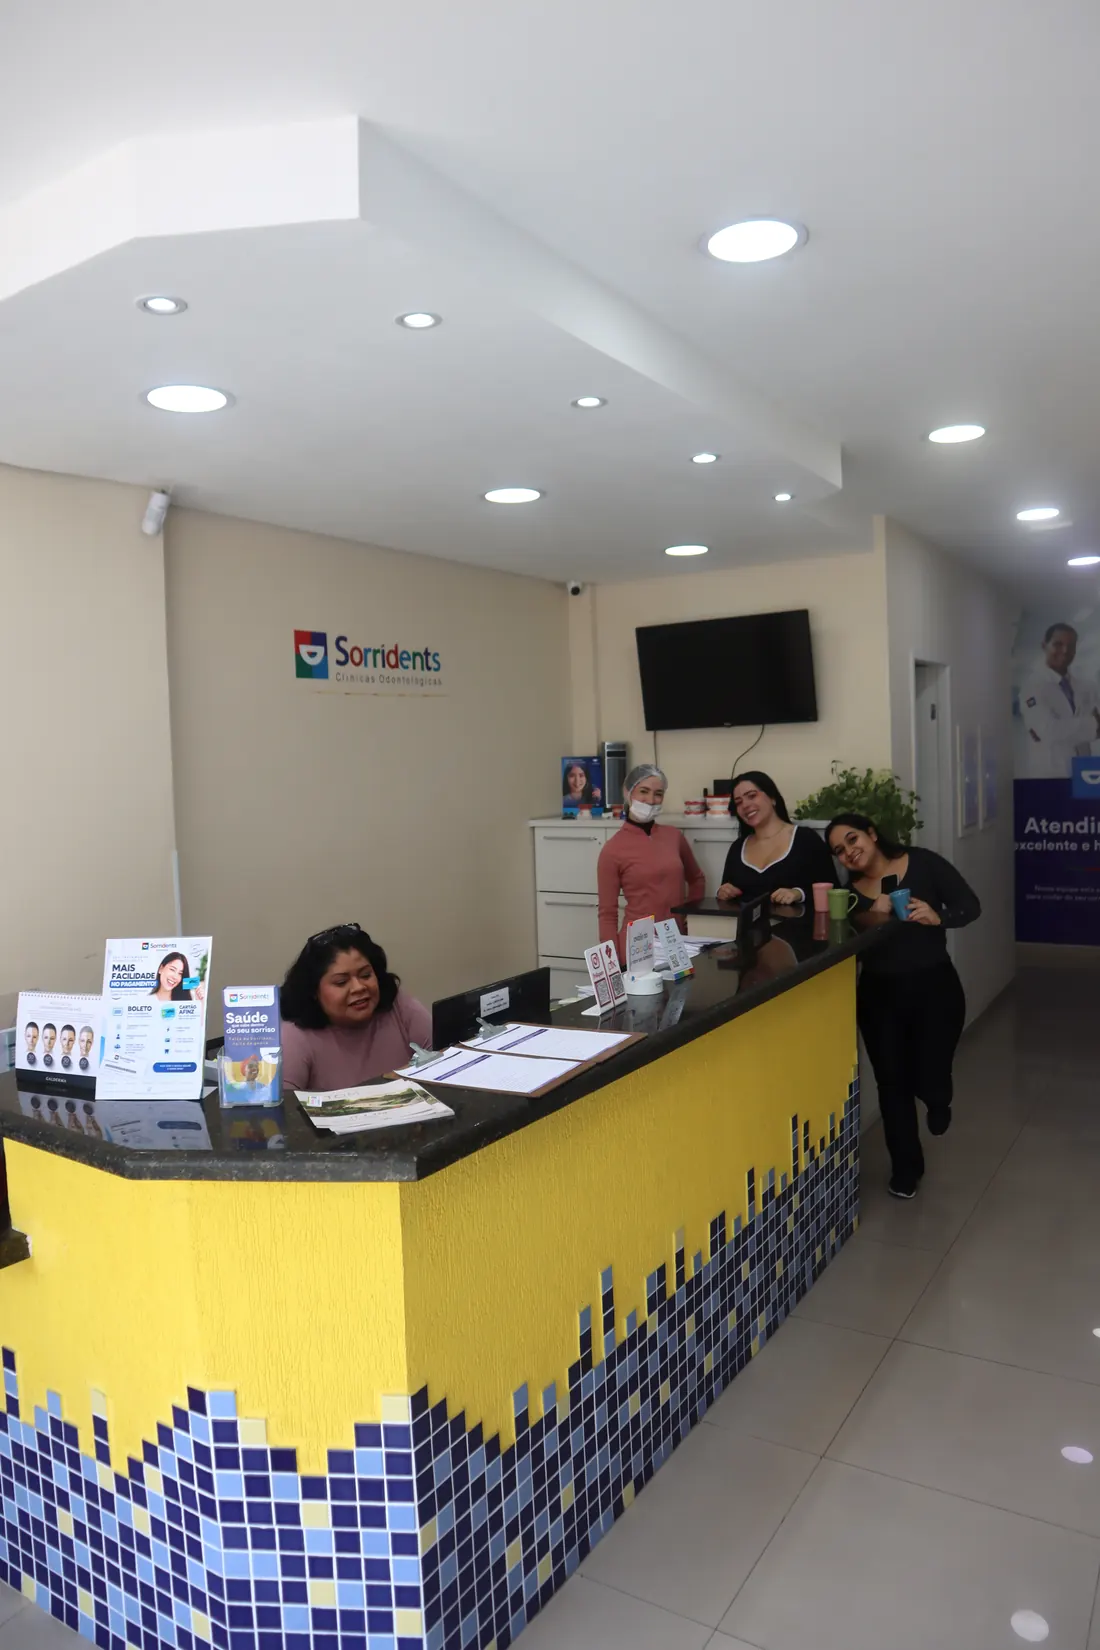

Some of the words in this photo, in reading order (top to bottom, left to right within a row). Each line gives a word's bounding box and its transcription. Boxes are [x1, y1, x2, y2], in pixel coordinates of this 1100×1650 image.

[334, 635, 441, 672] Sorridents
[1081, 842, 1090, 851] e
[112, 964, 136, 972] MAIS
[111, 972, 156, 980] FACILIDADE
[225, 1011, 269, 1024] Saúde
[250, 1026, 276, 1034] sorriso
